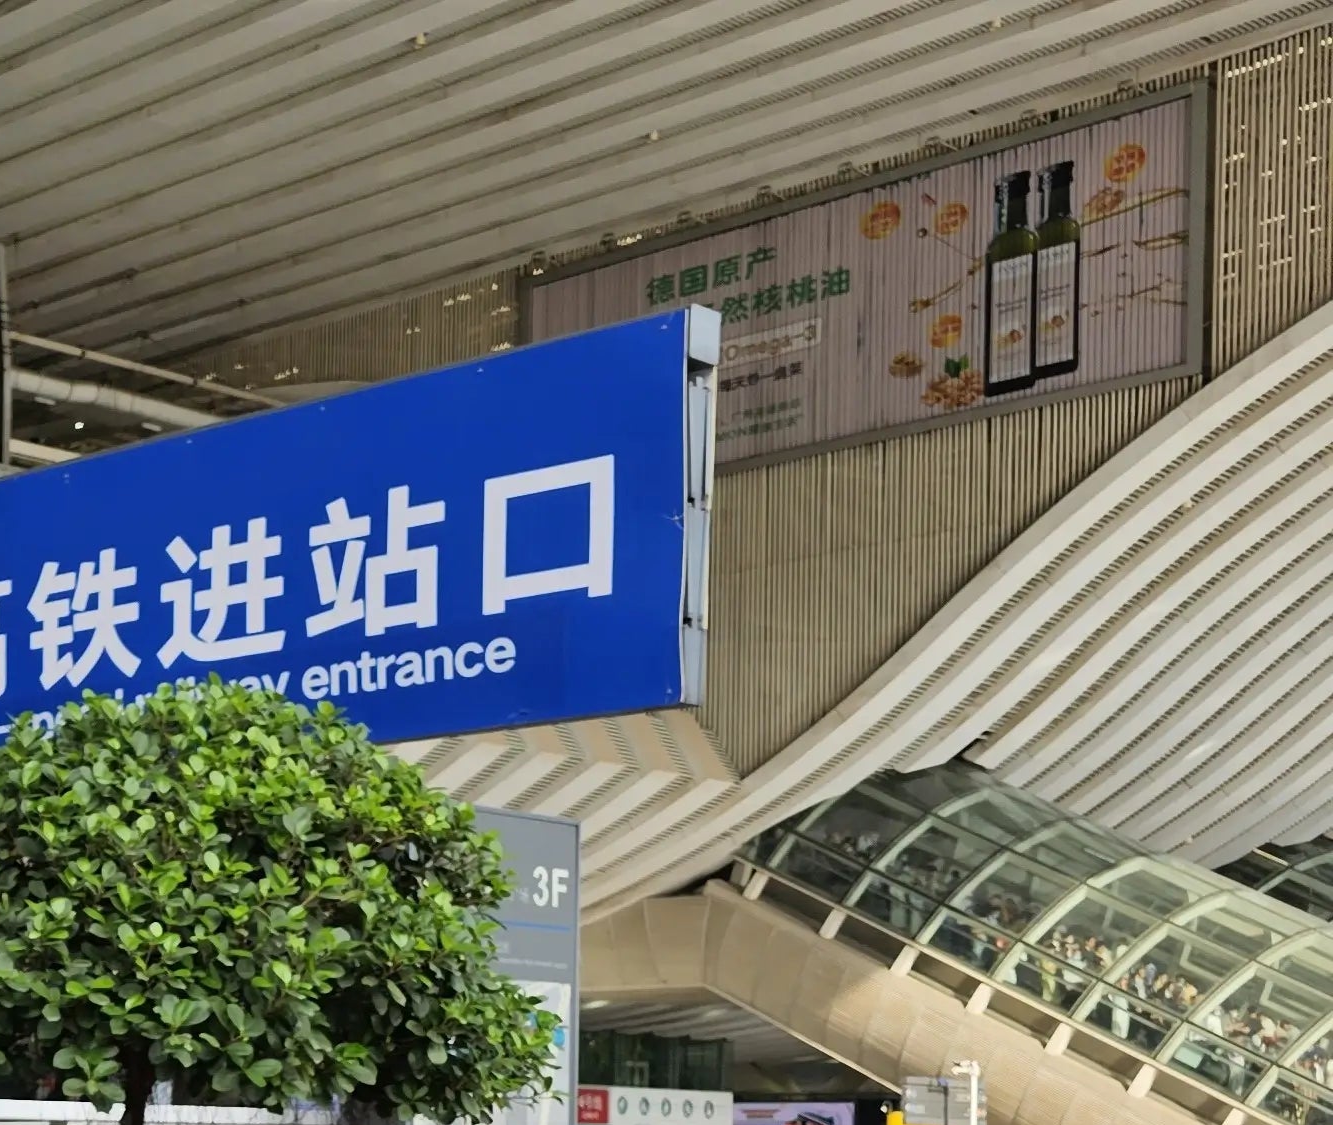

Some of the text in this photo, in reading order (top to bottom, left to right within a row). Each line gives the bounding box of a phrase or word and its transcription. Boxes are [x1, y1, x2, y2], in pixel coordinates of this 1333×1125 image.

[645, 246, 777, 307] 德国原产
[707, 265, 851, 326] 然核桃油
[301, 635, 517, 702] entrance
[532, 866, 569, 908] 3F
